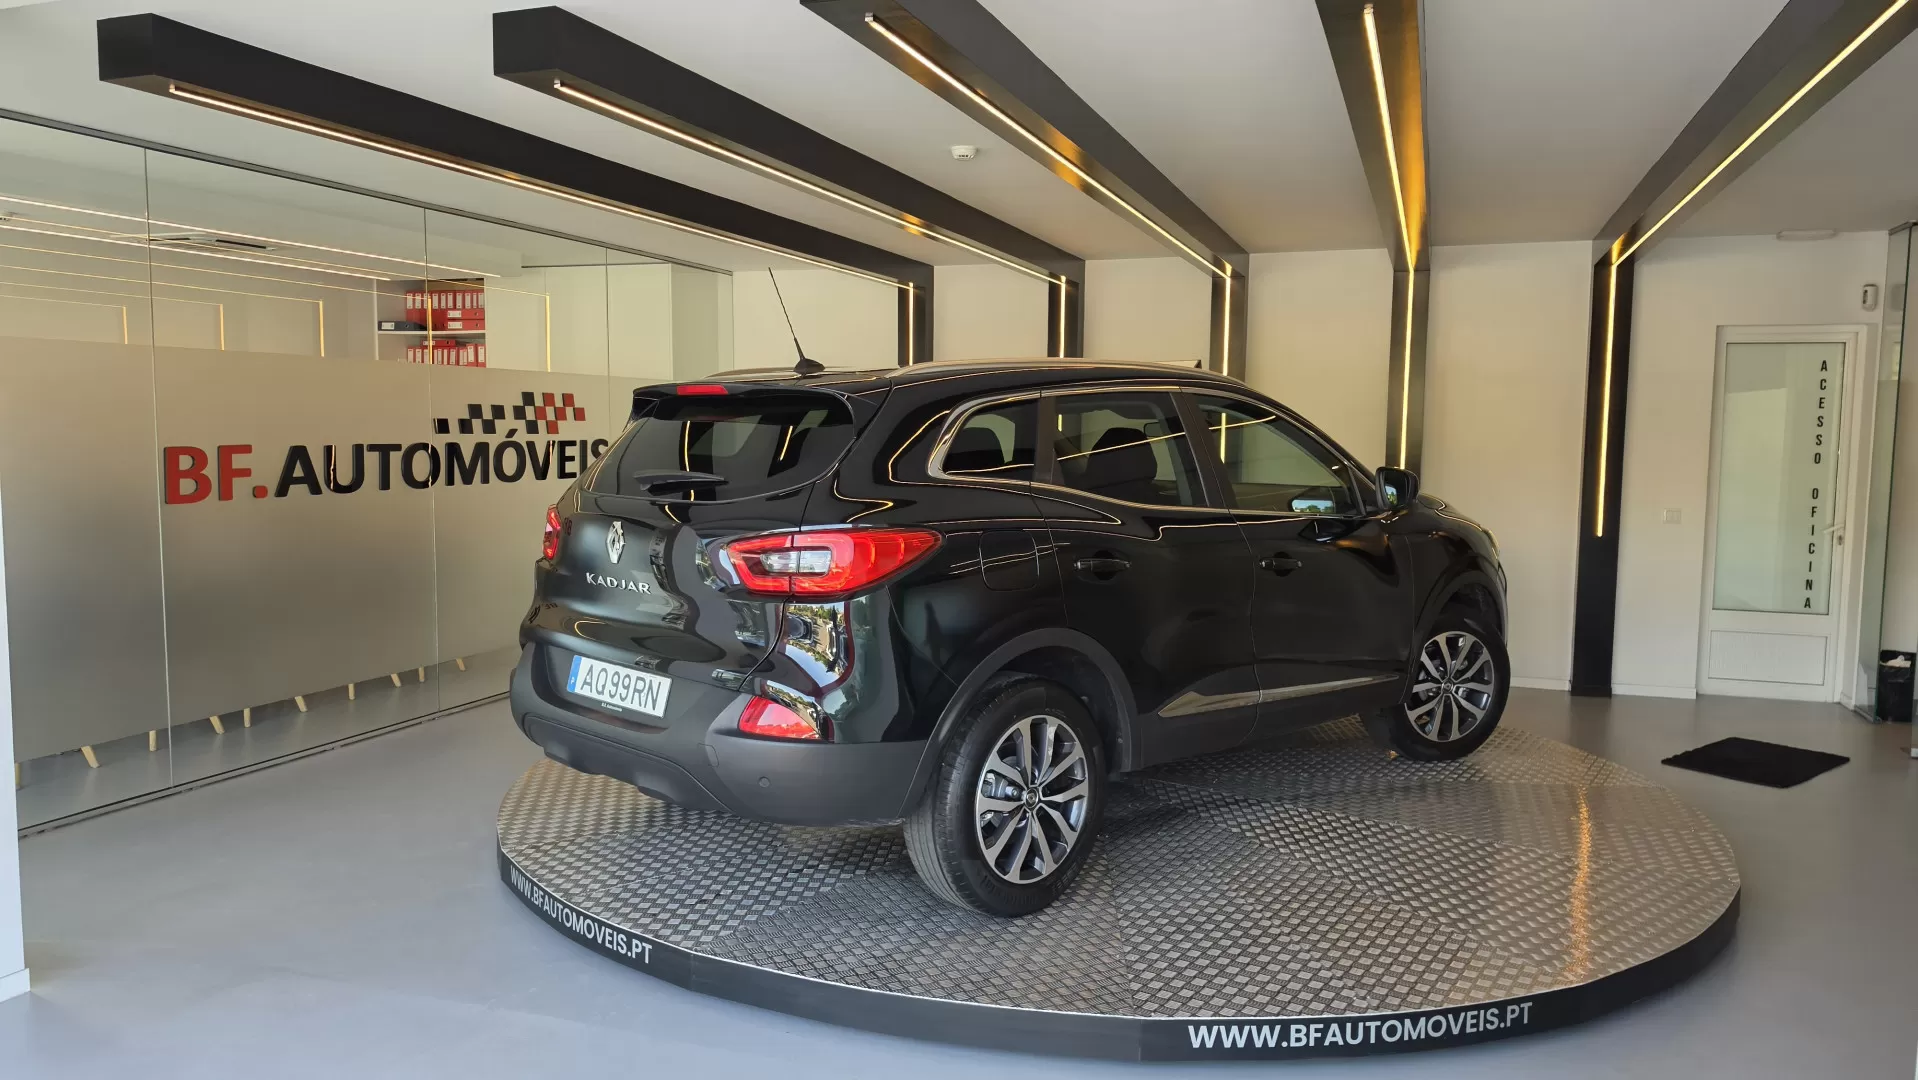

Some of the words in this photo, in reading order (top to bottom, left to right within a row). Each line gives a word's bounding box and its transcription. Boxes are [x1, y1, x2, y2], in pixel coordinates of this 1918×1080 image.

[1813, 359, 1828, 465] ACESSO
[586, 572, 651, 595] KADJAR
[1803, 487, 1819, 609] OFICINA
[580, 663, 662, 711] AQ99RN
[510, 865, 652, 964] WWW.BFAUTOMOVEIS.PT
[1187, 1001, 1534, 1049] WWW.BFAUTOMOVEIS.PT
